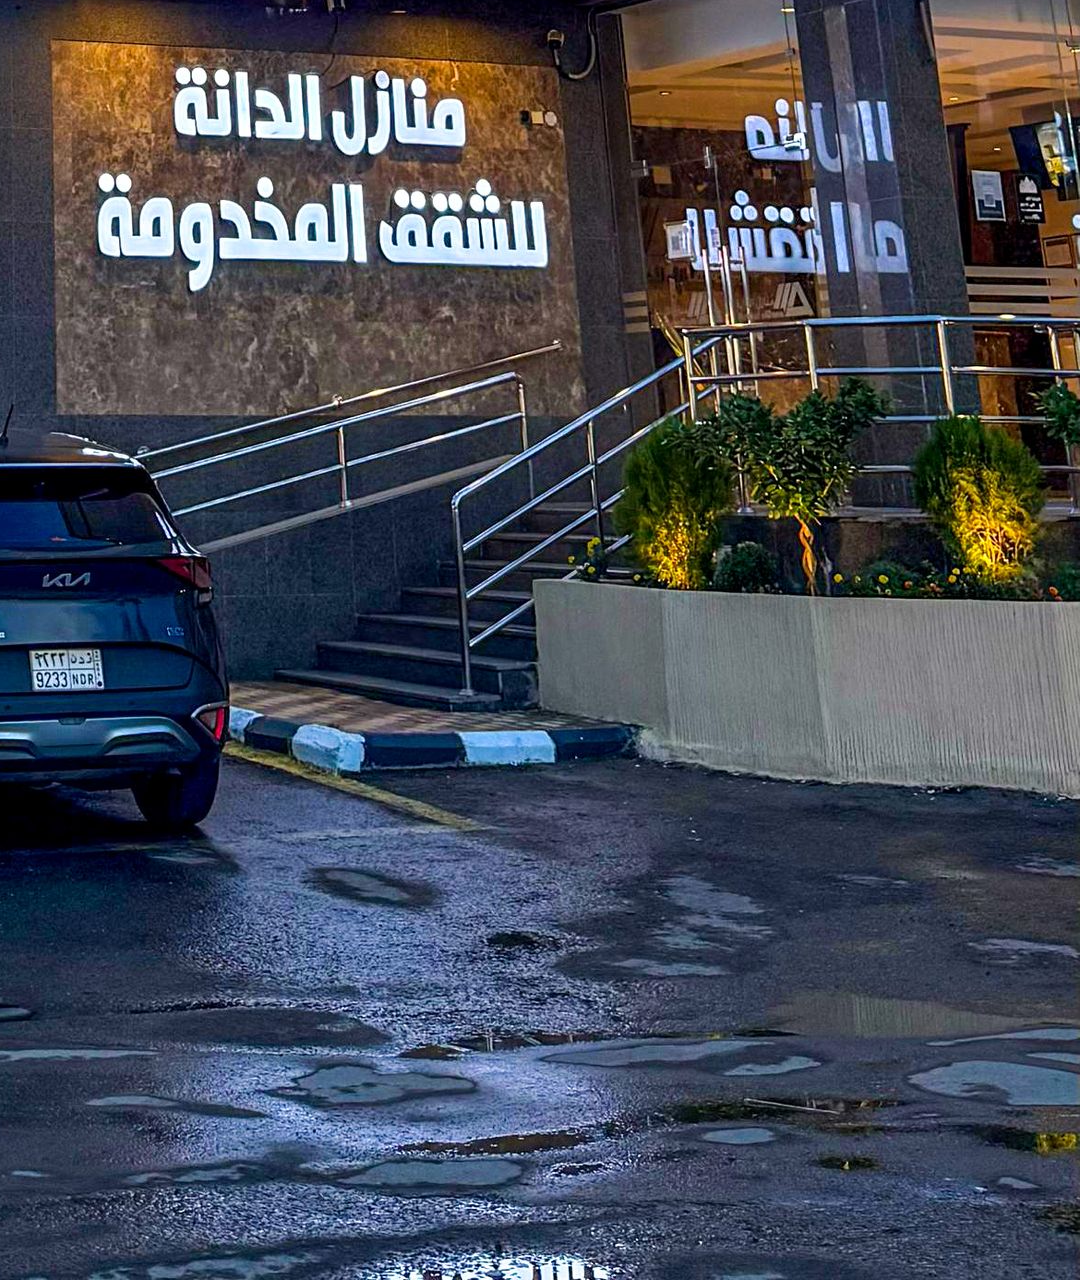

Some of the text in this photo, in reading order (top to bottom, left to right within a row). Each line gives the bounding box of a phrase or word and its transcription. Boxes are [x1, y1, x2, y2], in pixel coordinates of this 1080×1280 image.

[174, 66, 466, 156] منازل الدانة
[97, 173, 549, 292] للشقق المخدومة
[35, 671, 95, 689] 9233 NDR
